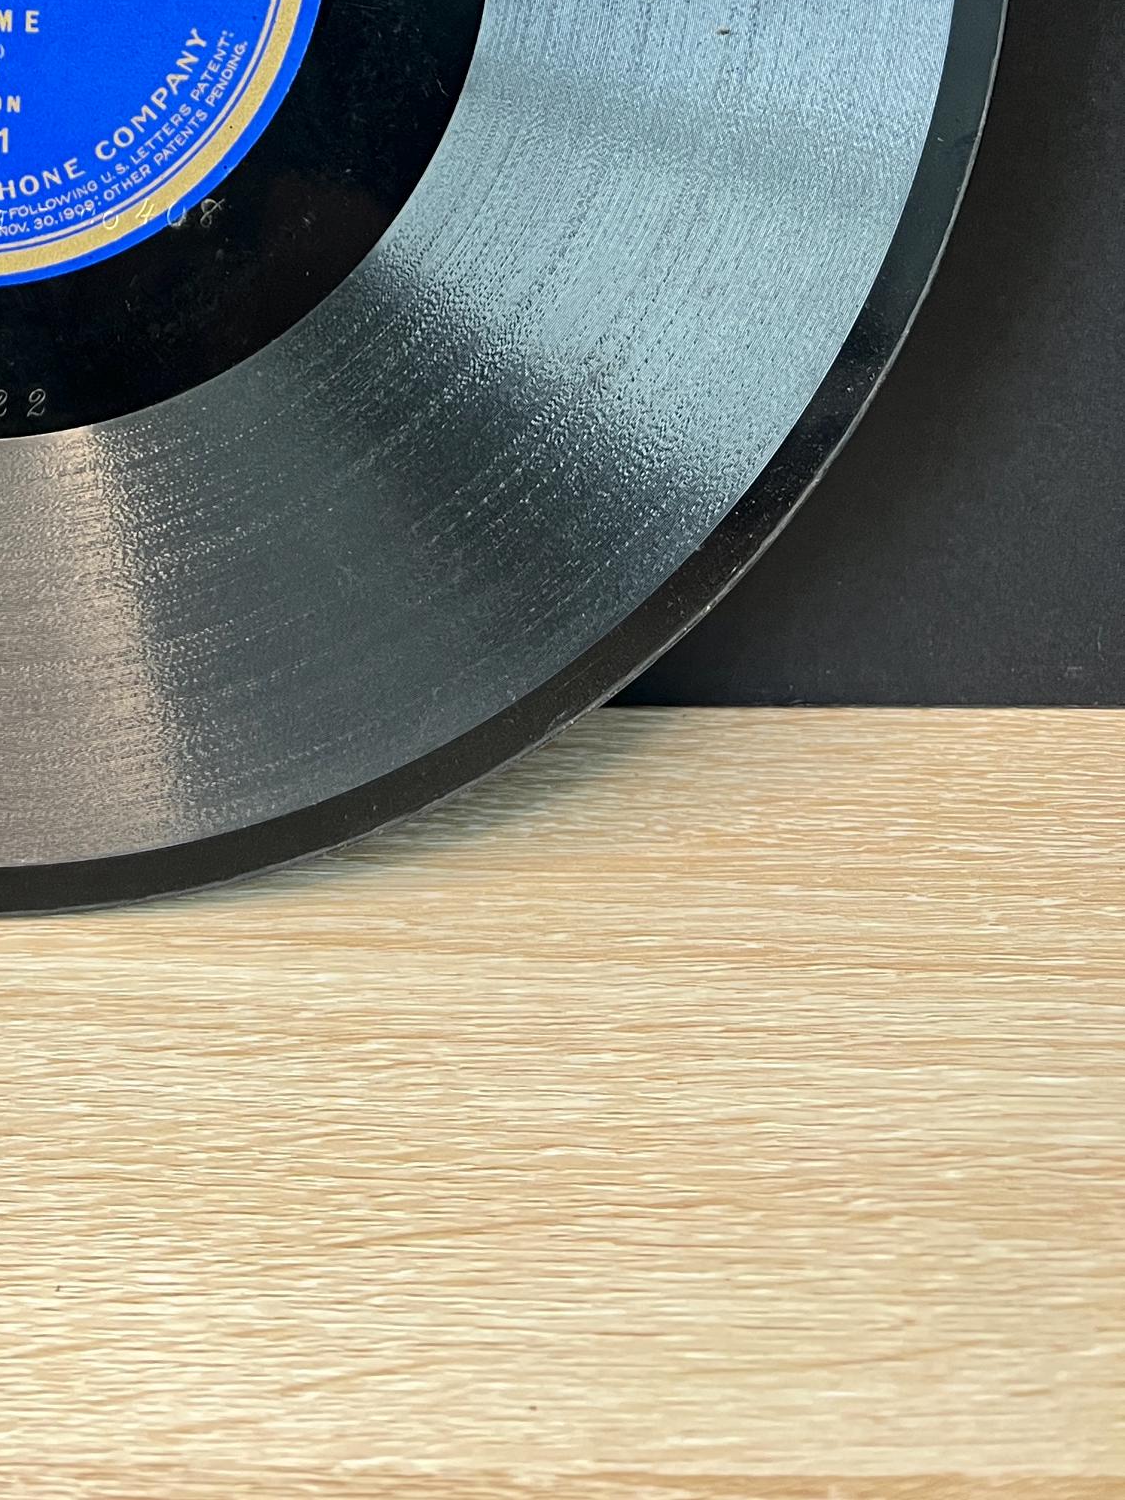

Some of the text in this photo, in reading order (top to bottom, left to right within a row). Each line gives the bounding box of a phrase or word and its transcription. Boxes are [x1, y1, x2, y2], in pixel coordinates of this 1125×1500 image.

[9, 181, 97, 218] FOLLOWING
[131, 104, 191, 164] LETTERS
[191, 31, 232, 100] PATENT:
[96, 28, 206, 160] COMPANY
[104, 165, 150, 200] OTHER
[154, 110, 207, 165] PATENTS
[206, 42, 247, 106] PENDING.
